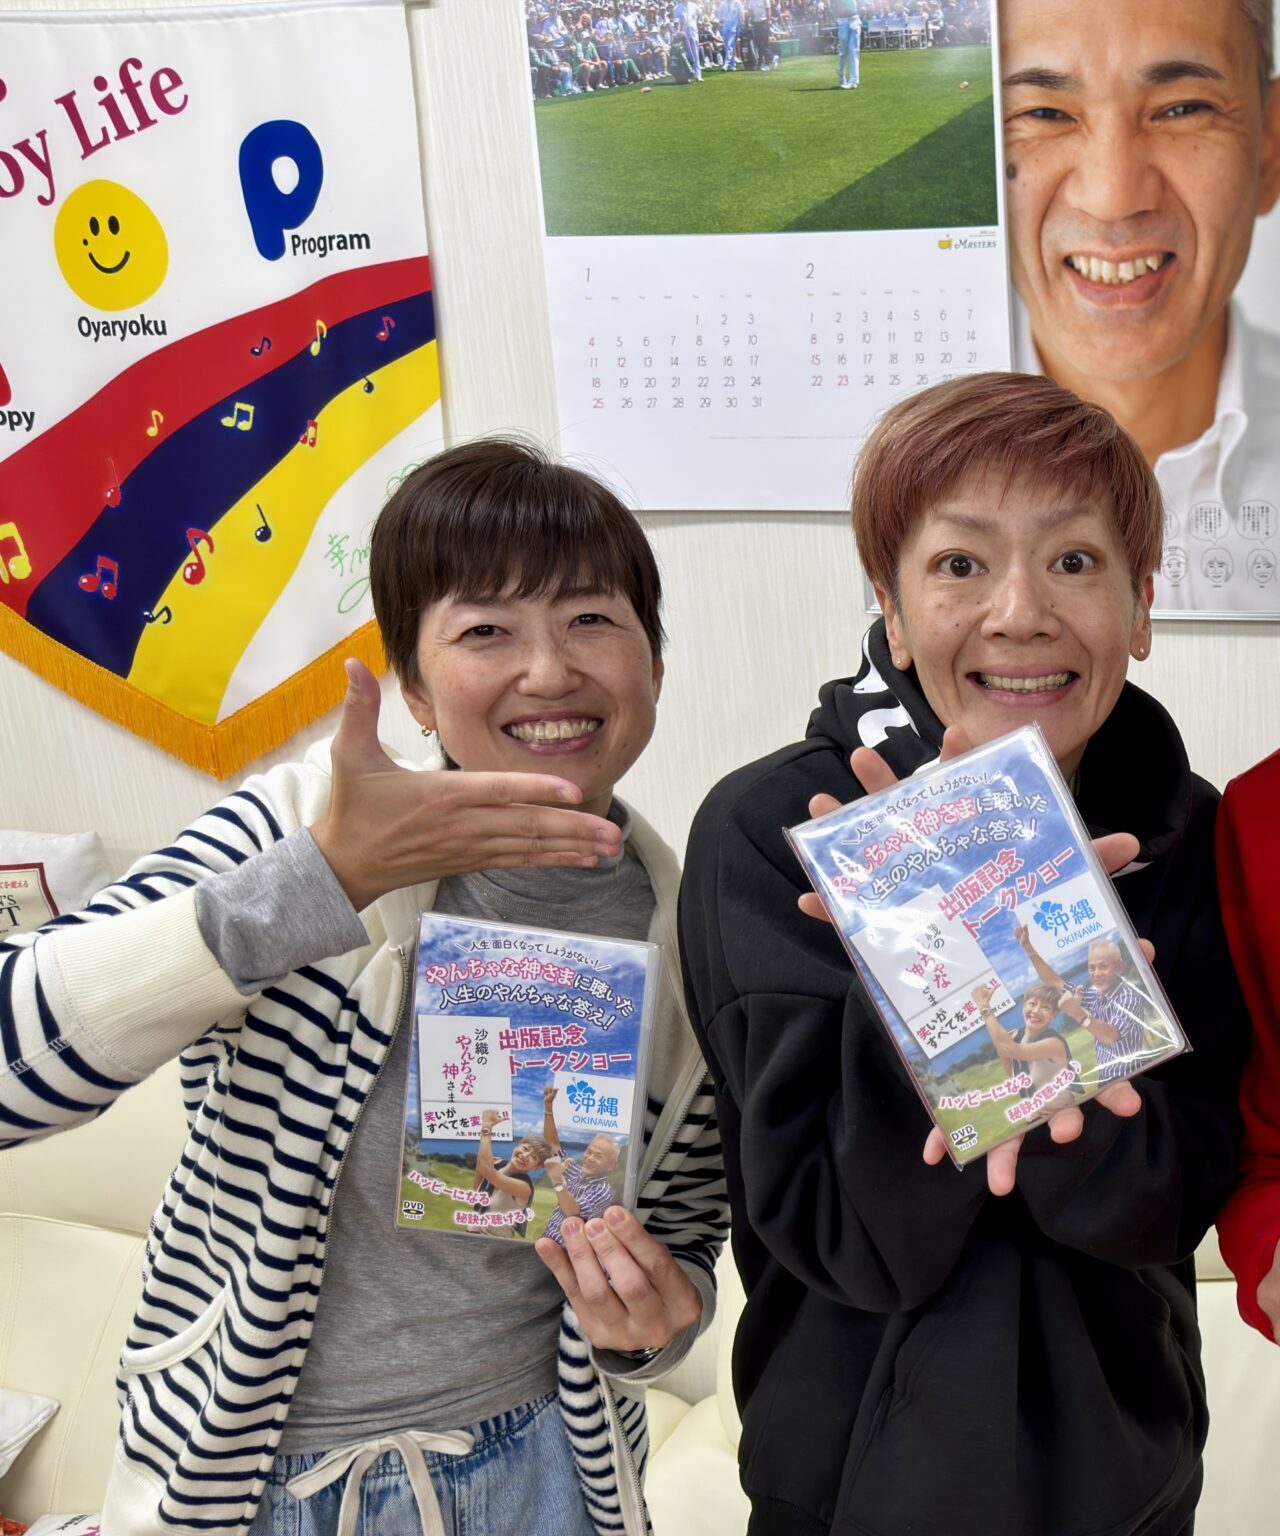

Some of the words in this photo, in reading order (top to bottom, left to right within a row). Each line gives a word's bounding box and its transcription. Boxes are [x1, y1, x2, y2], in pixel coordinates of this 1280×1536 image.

[54, 57, 189, 160] Life
[292, 230, 371, 257] Program
[586, 267, 591, 283] 1
[805, 262, 815, 279] 2
[721, 314, 727, 325] 2
[747, 313, 754, 325] 3
[836, 312, 841, 323] 2
[862, 311, 868, 323] 3
[887, 311, 893, 321] 4
[913, 310, 920, 321] 5
[940, 309, 947, 321] 6
[968, 309, 973, 320] 7
[77, 314, 167, 342] Oyaryoku
[811, 333, 817, 344] 8
[837, 333, 844, 344] 9
[862, 332, 871, 343] 10
[888, 332, 895, 342] 11
[914, 331, 923, 343] 12
[940, 331, 949, 342] 13
[967, 330, 975, 341] 14
[588, 337, 595, 347] 4
[616, 336, 623, 347] 5
[643, 336, 650, 347] 6
[670, 336, 676, 346] 7
[696, 335, 702, 346] 8
[723, 335, 730, 346] 9
[748, 334, 757, 345] 10
[590, 357, 598, 368] 11
[618, 357, 627, 368] 12
[644, 356, 653, 368] 13
[670, 356, 680, 367] 14
[697, 356, 706, 367] 15
[723, 356, 733, 366] 16
[750, 355, 759, 366] 17
[812, 354, 821, 365] 15
[838, 354, 847, 365] 16
[864, 353, 872, 364] 17
[889, 353, 898, 364] 18
[915, 353, 925, 364] 19
[940, 352, 952, 364] 20
[968, 352, 976, 363] 21
[592, 377, 601, 388] 18
[619, 377, 628, 388] 19
[645, 377, 656, 388] 20
[672, 377, 680, 388] 21
[698, 377, 709, 387] 22
[723, 376, 735, 387] 23
[751, 376, 761, 387] 24
[812, 375, 823, 386] 22
[837, 375, 849, 386] 23
[864, 374, 874, 386] 24
[889, 374, 900, 385] 25
[593, 398, 604, 408] 25
[621, 397, 633, 408] 26
[646, 397, 658, 408] 27
[673, 397, 684, 408] 28
[700, 397, 711, 408] 29
[726, 397, 738, 408] 30
[752, 396, 762, 408] 31
[937, 847, 1024, 921] 出版記念
[961, 847, 1075, 940] トークショー
[1047, 898, 1096, 936] 沖縄
[1056, 921, 1103, 949] OKINAWA
[426, 957, 634, 1017] やんちゃな神さまに聴いた
[474, 1028, 489, 1065] 沙織の
[499, 1024, 586, 1050] 出版記念
[456, 1035, 476, 1095] やんちゃな
[509, 1052, 631, 1075] トークショー
[442, 1063, 459, 1103] 神さま
[940, 1074, 1031, 1108] ハッピーになる
[424, 1108, 456, 1122] 笑いが
[574, 1092, 619, 1117] 沖縄
[573, 1115, 618, 1129] OKINAWA
[951, 1125, 973, 1141] DVD
[409, 1172, 490, 1205] ハッピーになる
[404, 1201, 423, 1210] DVD
